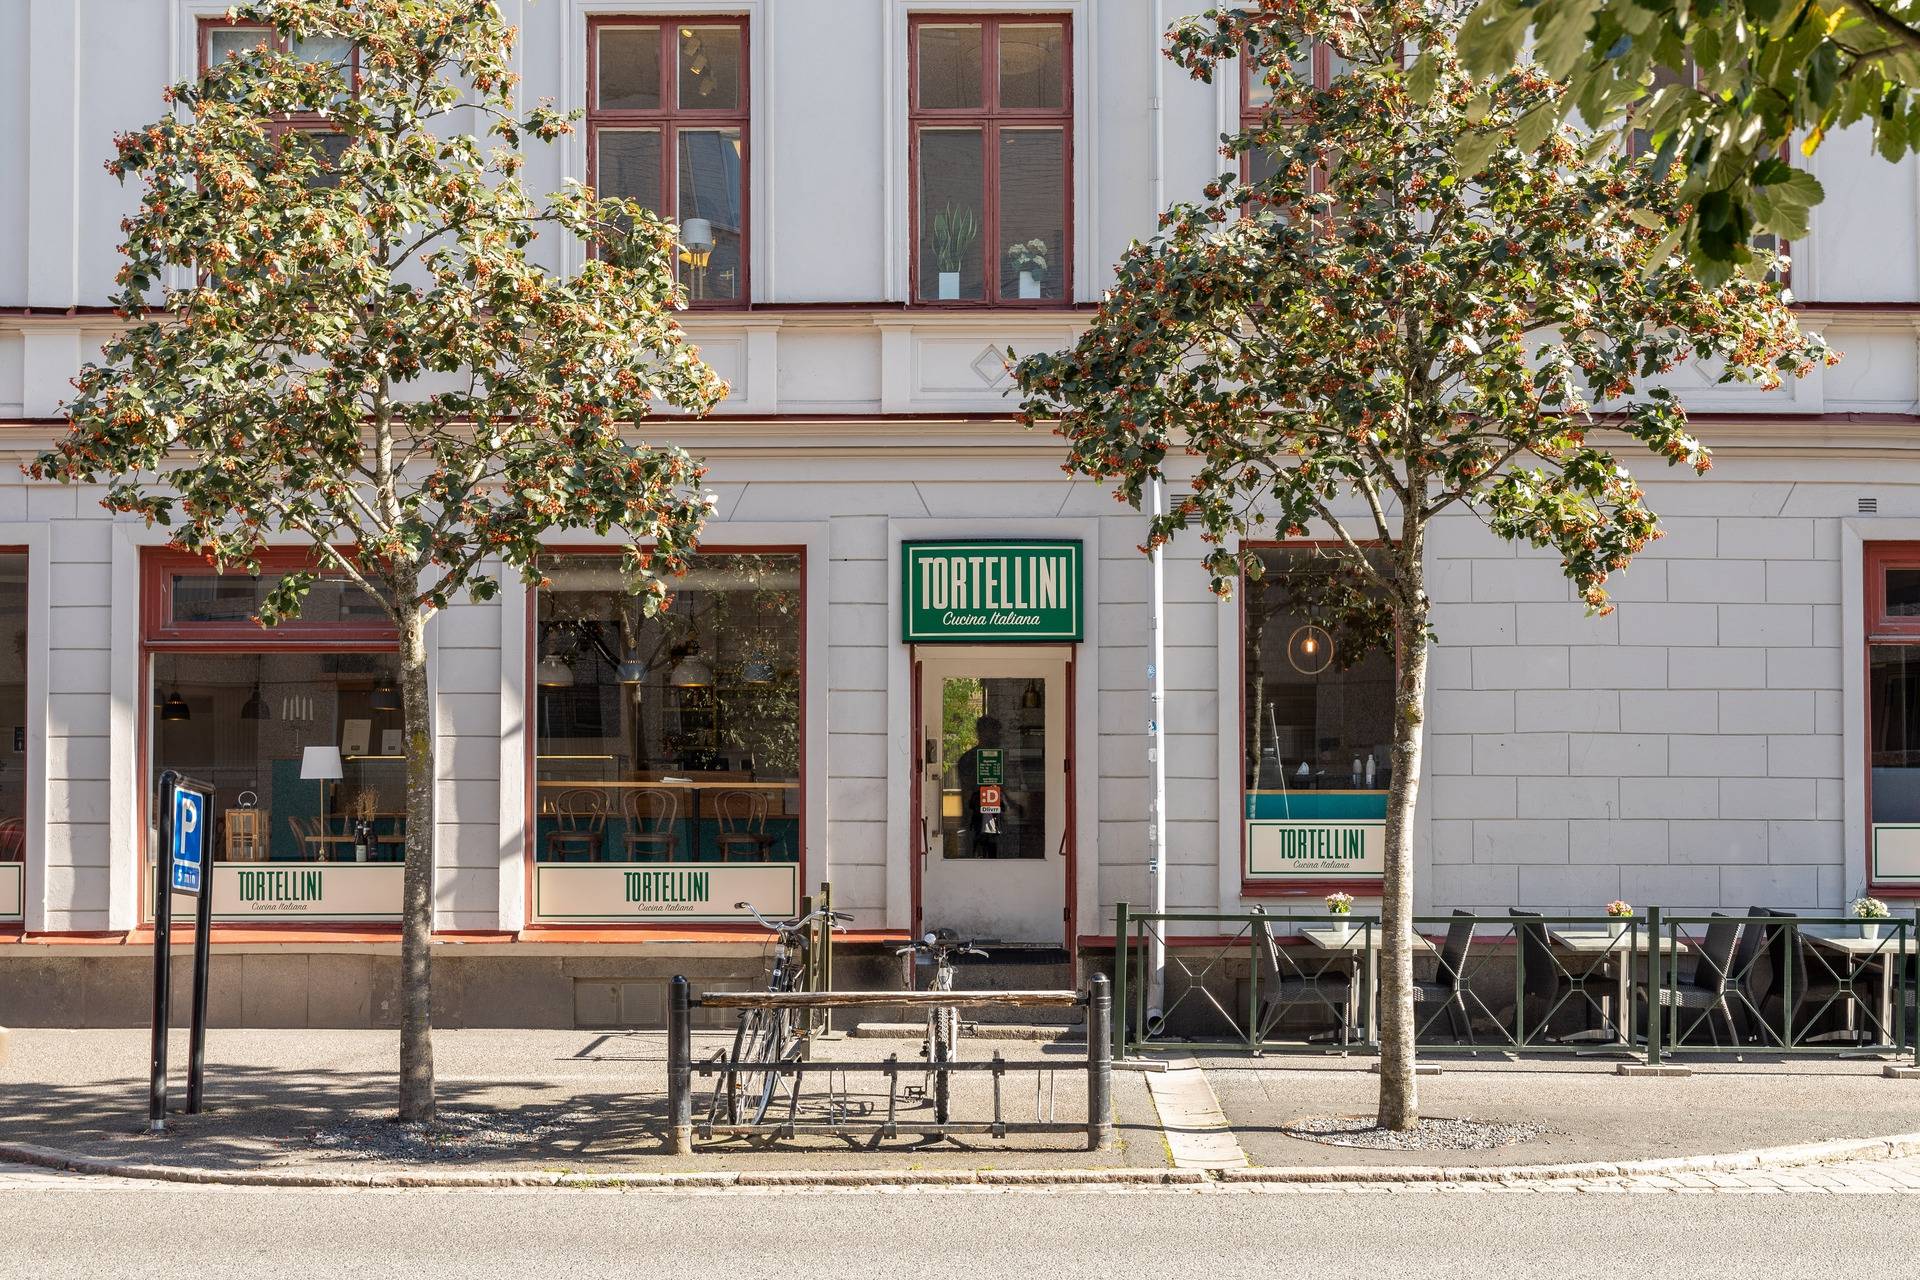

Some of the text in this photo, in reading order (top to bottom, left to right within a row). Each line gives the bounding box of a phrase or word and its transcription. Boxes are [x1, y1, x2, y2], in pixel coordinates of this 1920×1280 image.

[918, 556, 1067, 609] TORTELLINI
[942, 611, 1041, 626] Cucina Italiana
[180, 797, 197, 854] P
[1279, 829, 1365, 859] TORTELLINI
[1293, 860, 1351, 869] Cucina Italiana
[177, 869, 196, 885] 5 min
[238, 871, 323, 901] TORTELLINI
[624, 872, 709, 902] TORTELLINI
[251, 902, 308, 911] Cucina Italiana
[637, 903, 694, 912] Cucina Italiana
